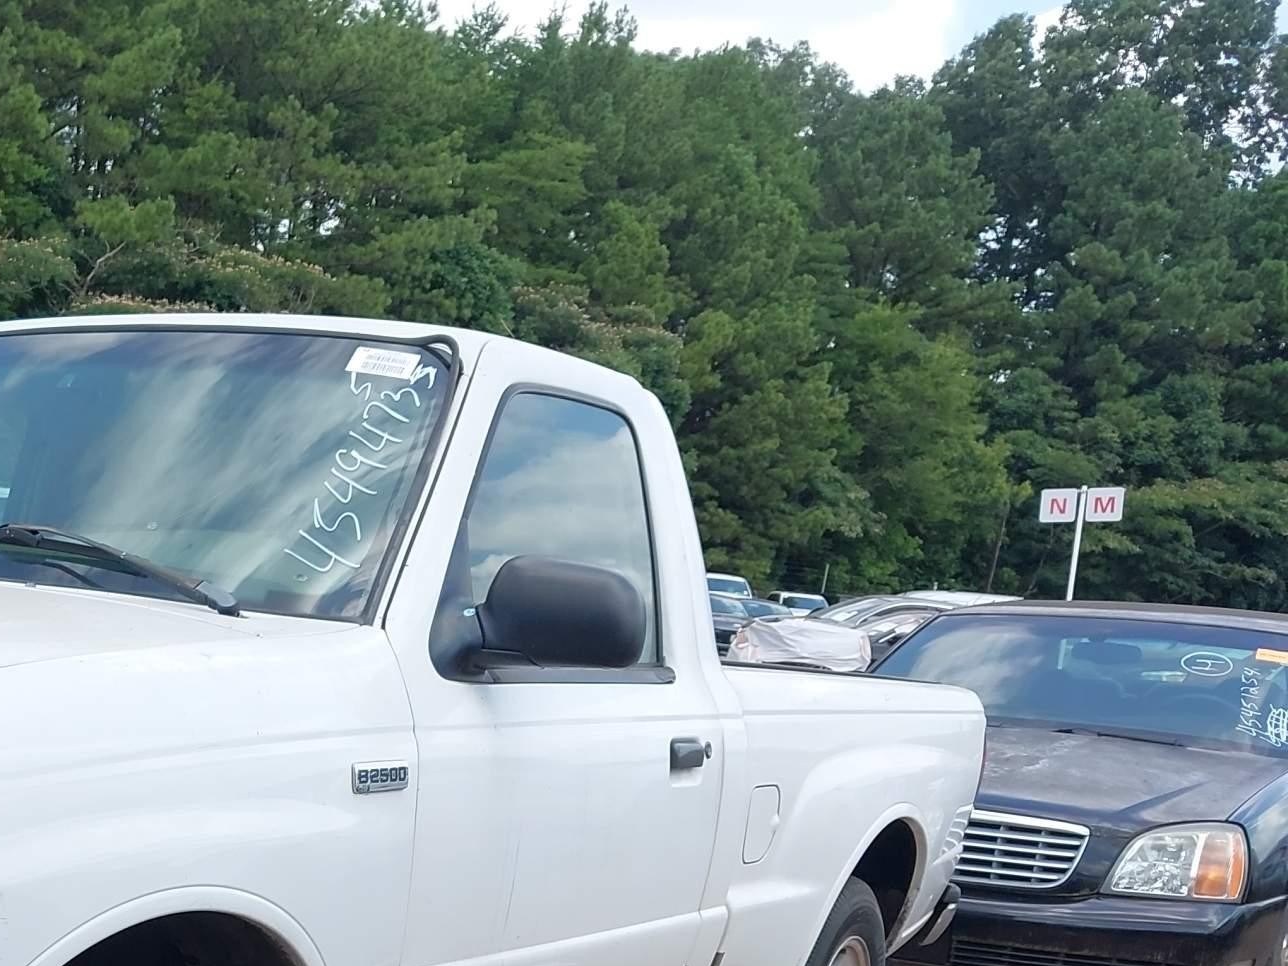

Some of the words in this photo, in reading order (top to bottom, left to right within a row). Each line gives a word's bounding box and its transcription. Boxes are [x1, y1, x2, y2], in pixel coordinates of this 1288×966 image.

[1050, 498, 1067, 515] N
[1094, 496, 1116, 514] M
[358, 766, 409, 785] B2500
